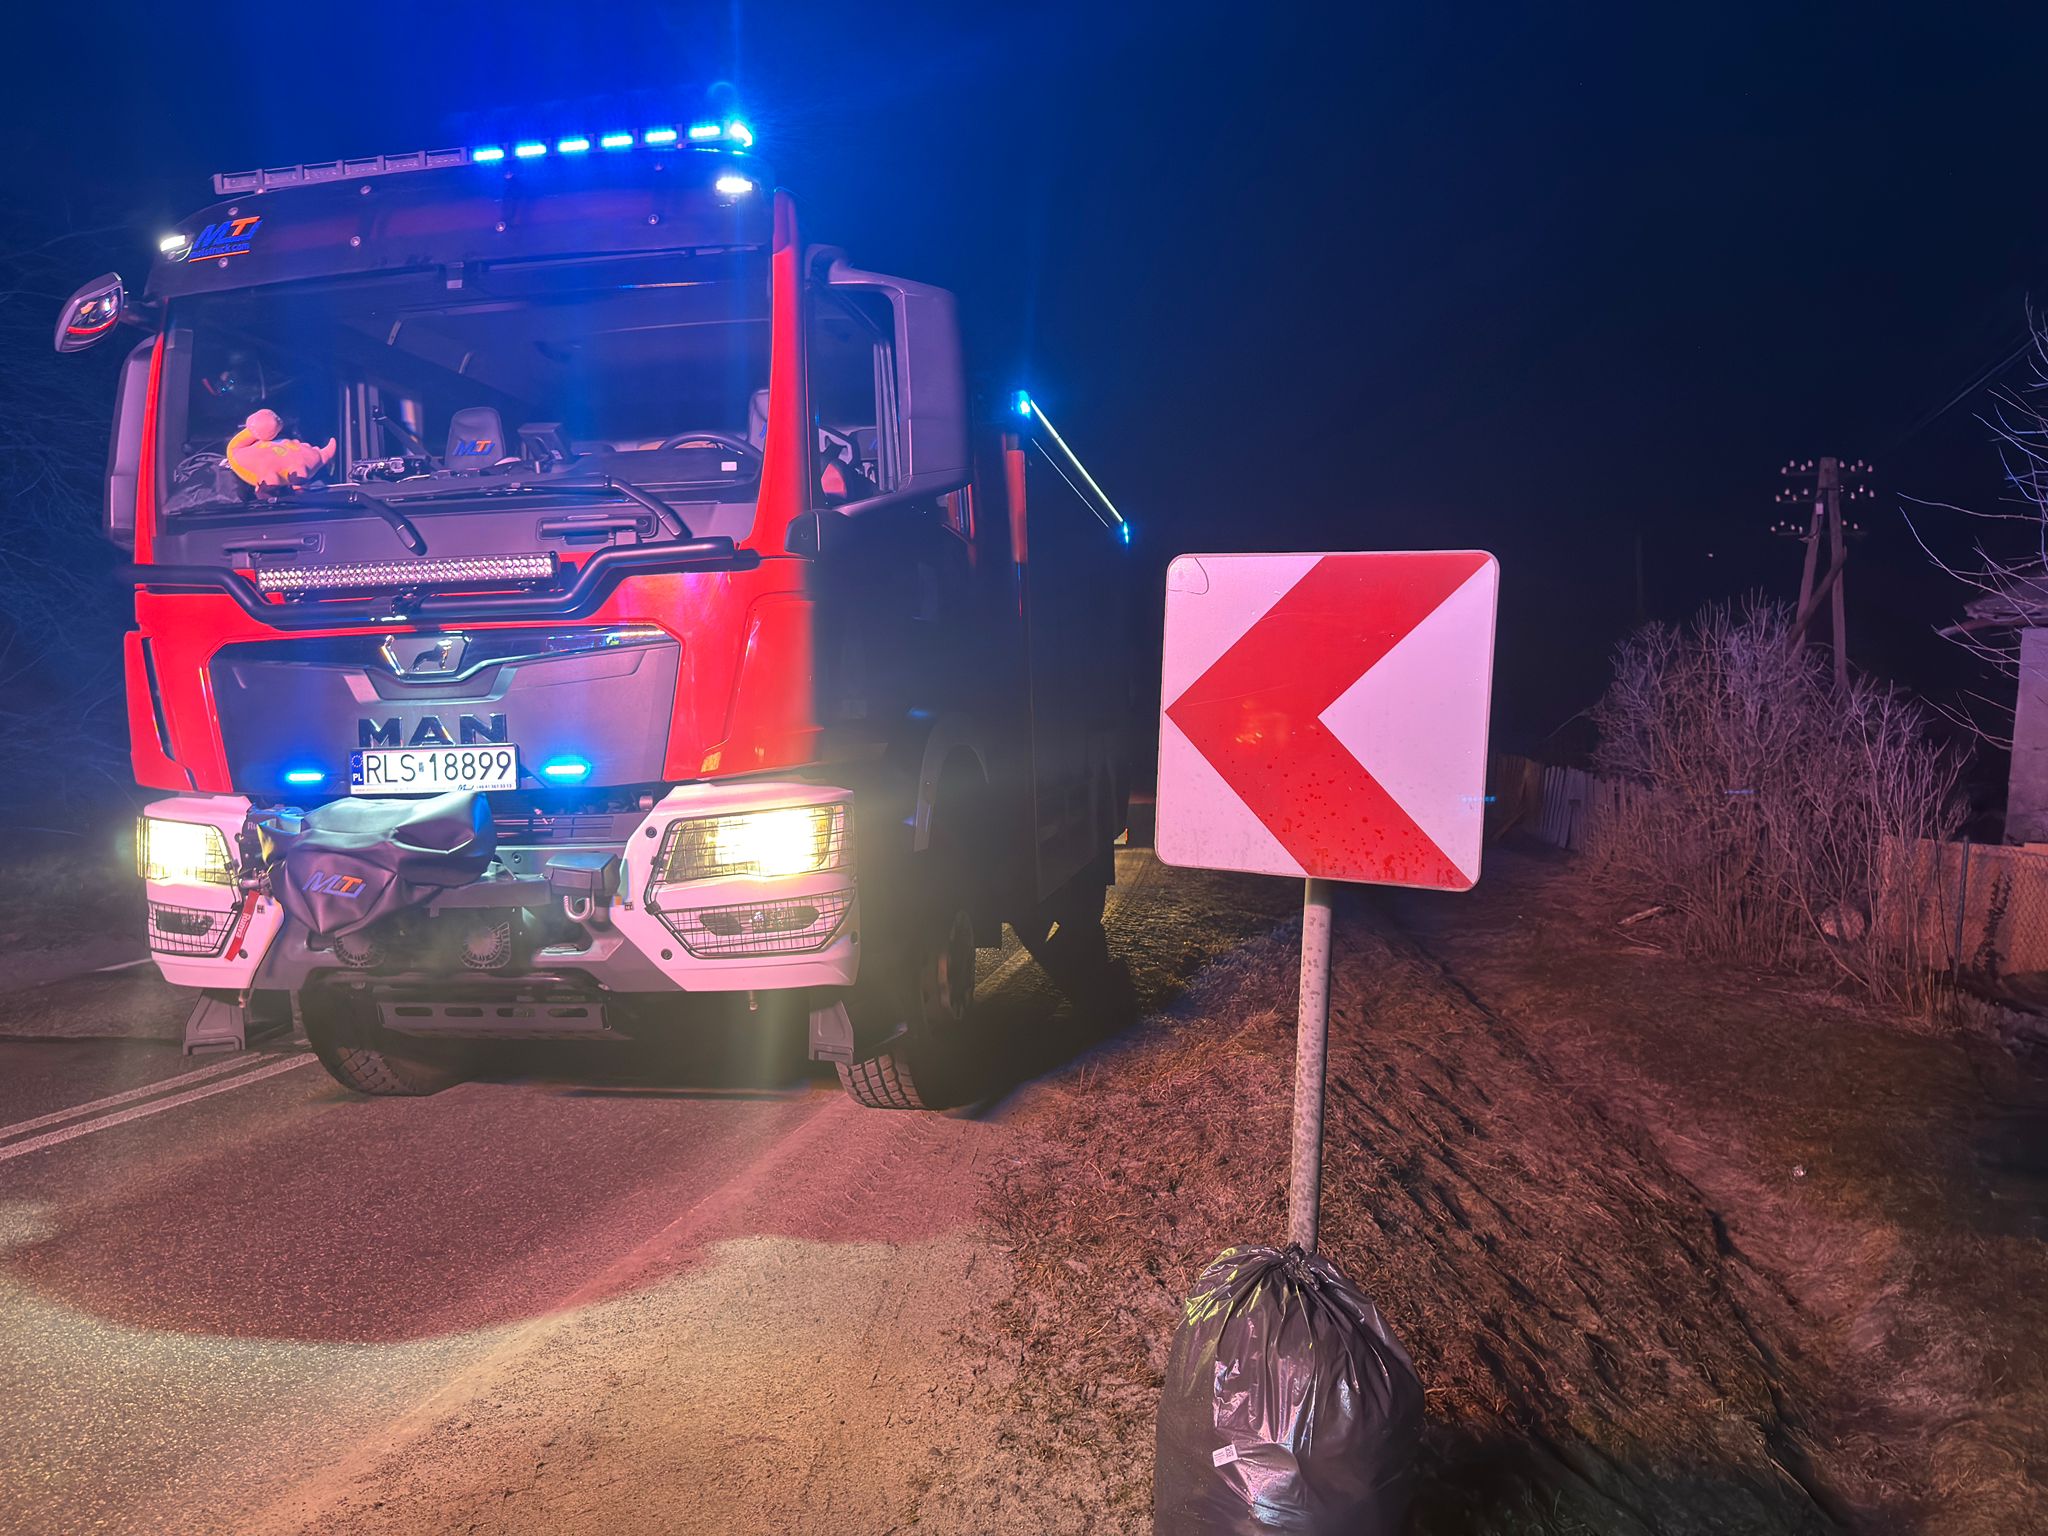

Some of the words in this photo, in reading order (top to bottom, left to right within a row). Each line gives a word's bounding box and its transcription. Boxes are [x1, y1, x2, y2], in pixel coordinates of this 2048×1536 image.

[358, 713, 508, 747] MAN
[352, 773, 363, 782] PL
[366, 754, 416, 784] RLS
[429, 751, 512, 781] 18899
